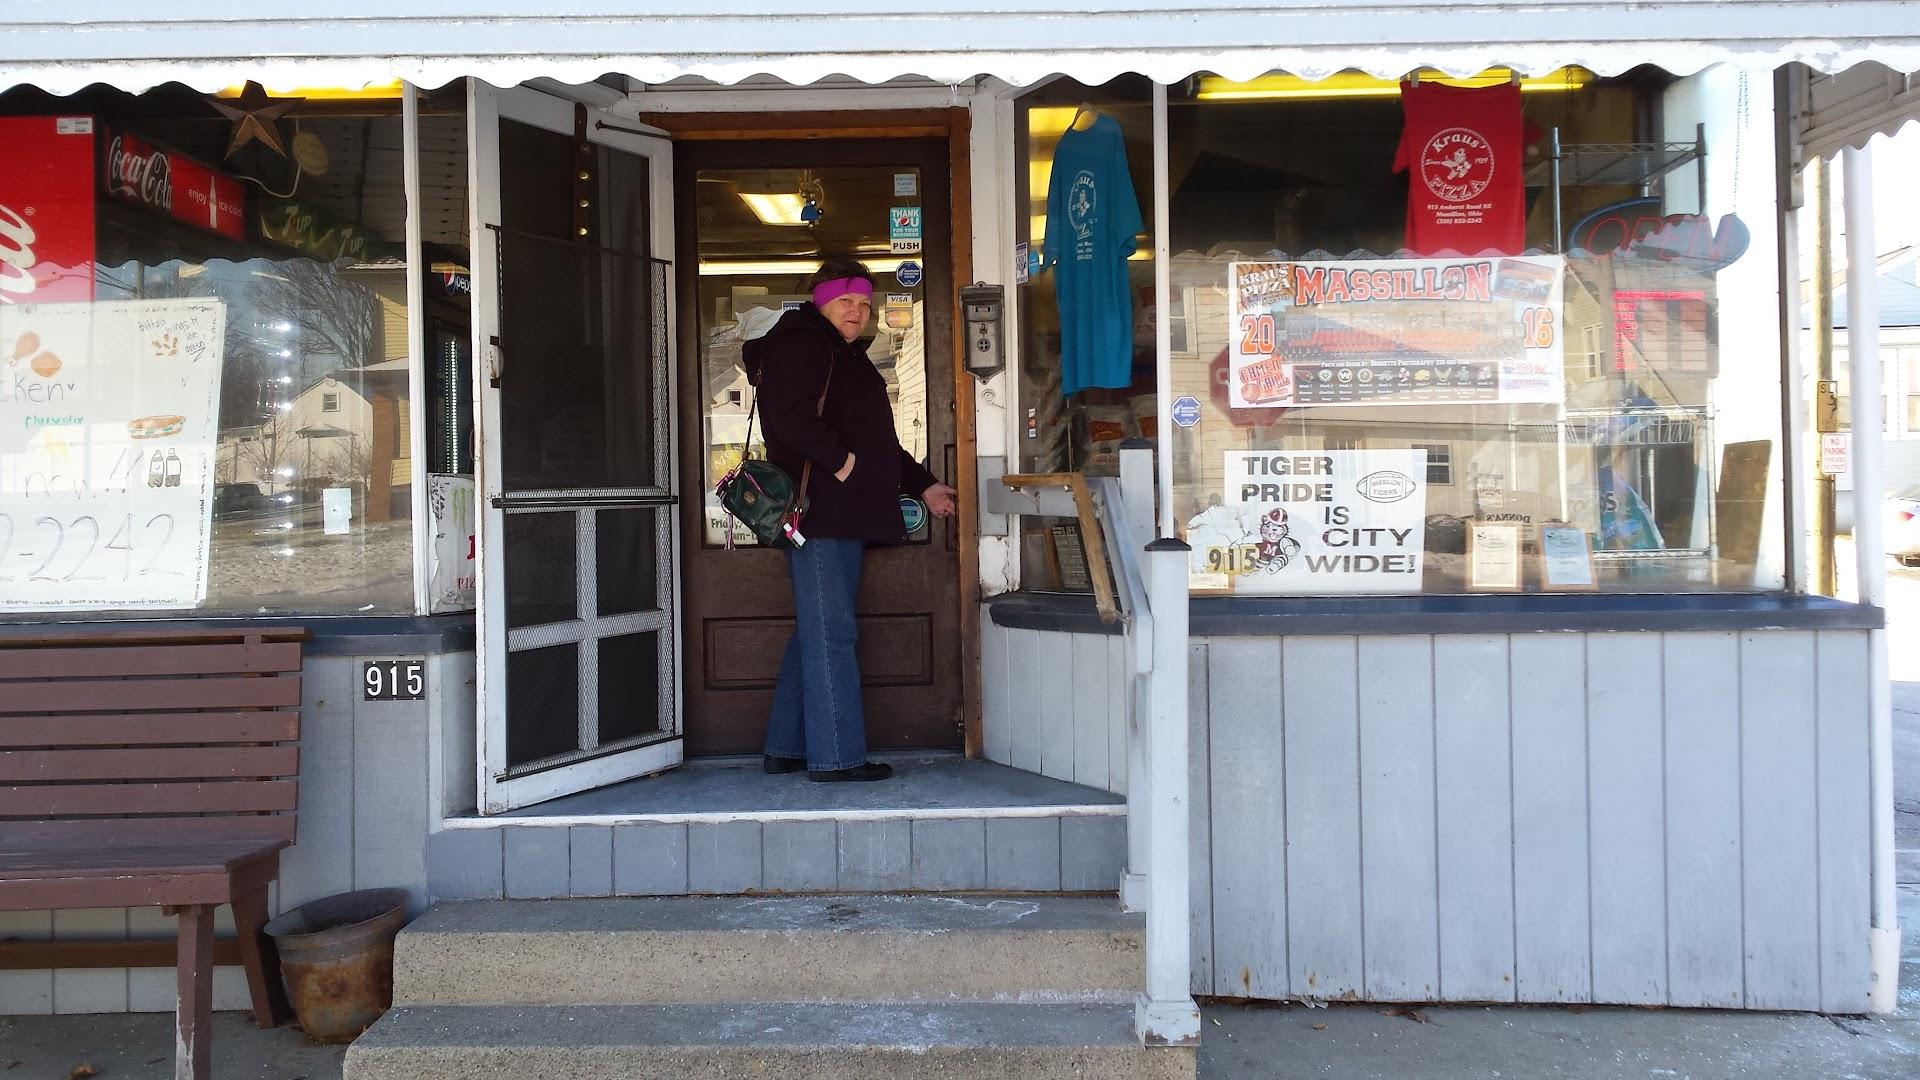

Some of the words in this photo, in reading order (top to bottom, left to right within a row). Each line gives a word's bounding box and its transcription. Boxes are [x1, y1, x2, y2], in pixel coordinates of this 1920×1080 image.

[188, 187, 207, 206] enjoy
[1429, 175, 1486, 199] PIZZA
[891, 209, 919, 218] THANK
[893, 242, 920, 250] PUSH
[1586, 215, 1731, 261] OPEN
[1240, 265, 1289, 286] KRAUS
[1295, 263, 1491, 306] MASSILLON
[1241, 278, 1291, 298] PIZZA
[1241, 314, 1275, 354] 20
[1522, 308, 1553, 348] 16
[1242, 456, 1333, 475] TIGER
[1241, 483, 1333, 502] PRIDE
[1325, 506, 1350, 525] IS
[1322, 528, 1412, 547] CITY
[1208, 547, 1257, 573] 915
[1305, 554, 1416, 573] WIDE!
[366, 665, 422, 696] 915
